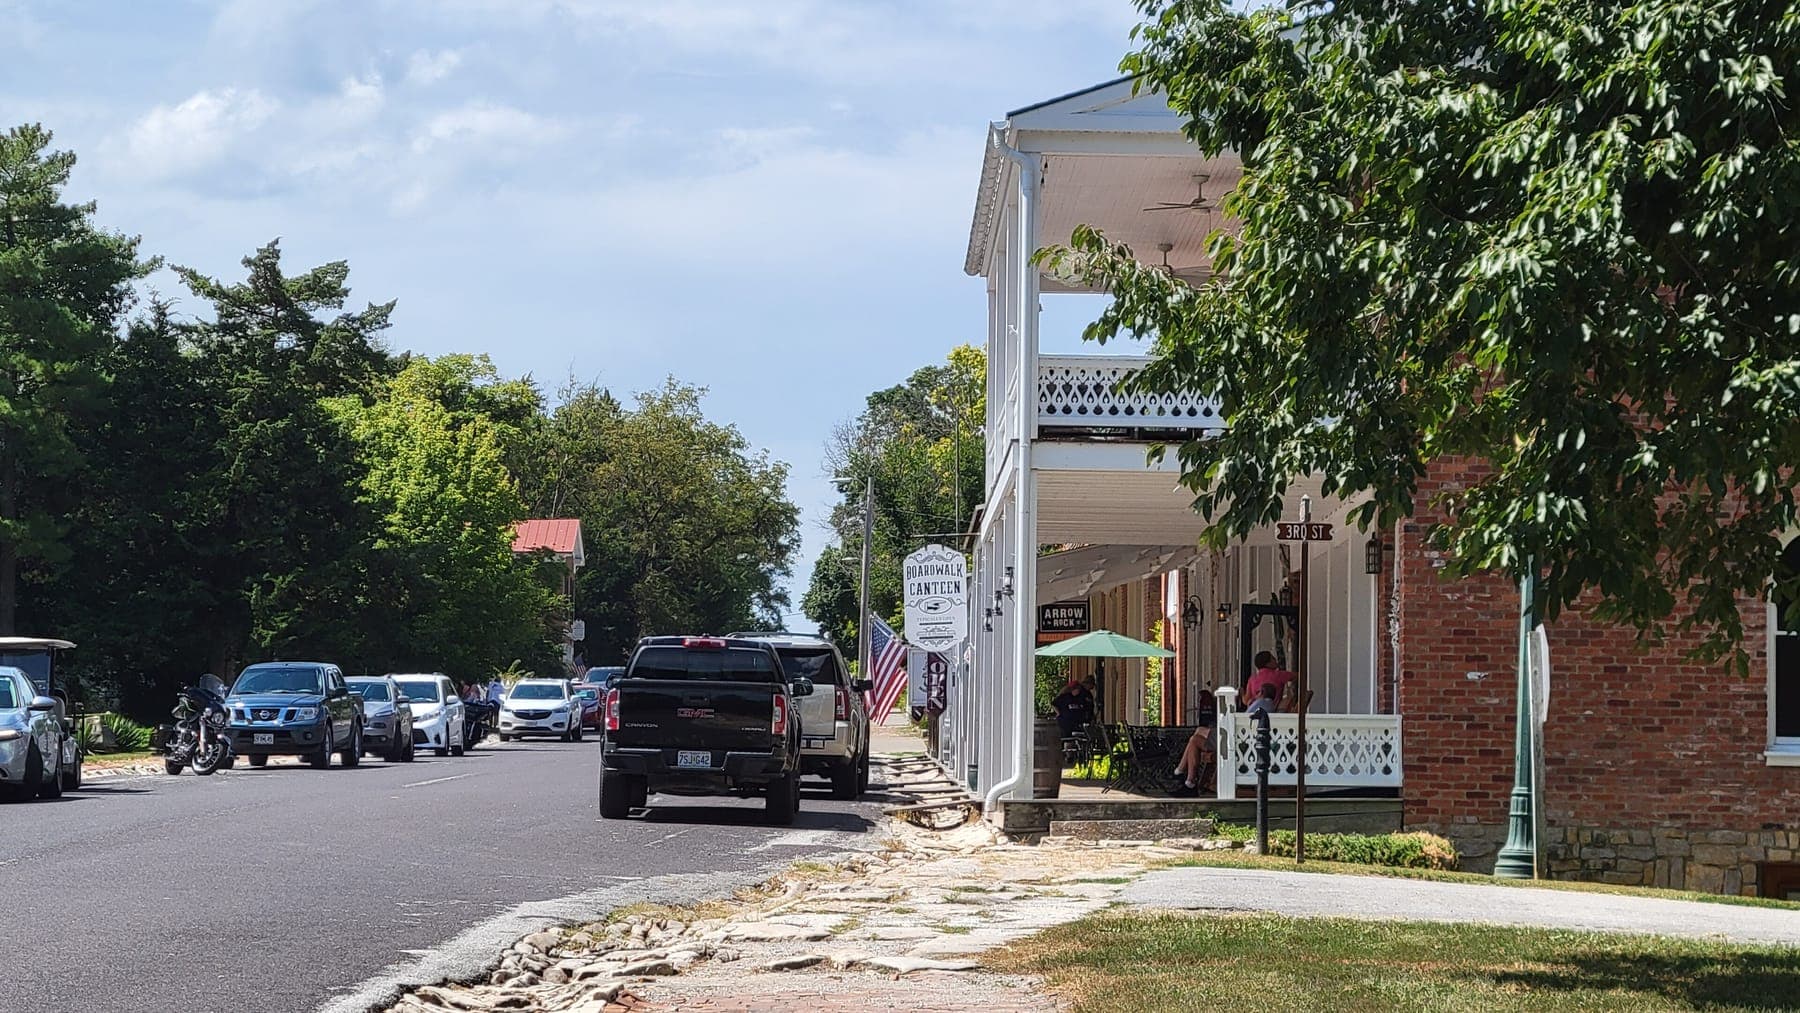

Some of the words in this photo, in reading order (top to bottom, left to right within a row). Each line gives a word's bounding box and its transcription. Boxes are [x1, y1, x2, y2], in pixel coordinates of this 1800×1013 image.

[1286, 525, 1307, 539] 3RD
[1311, 525, 1324, 539] ST
[906, 563, 964, 580] BOARDWALK
[909, 581, 961, 596] CANTEEN
[1044, 607, 1083, 619] ARROW
[1053, 618, 1075, 627] ROCK
[677, 707, 715, 719] GMC
